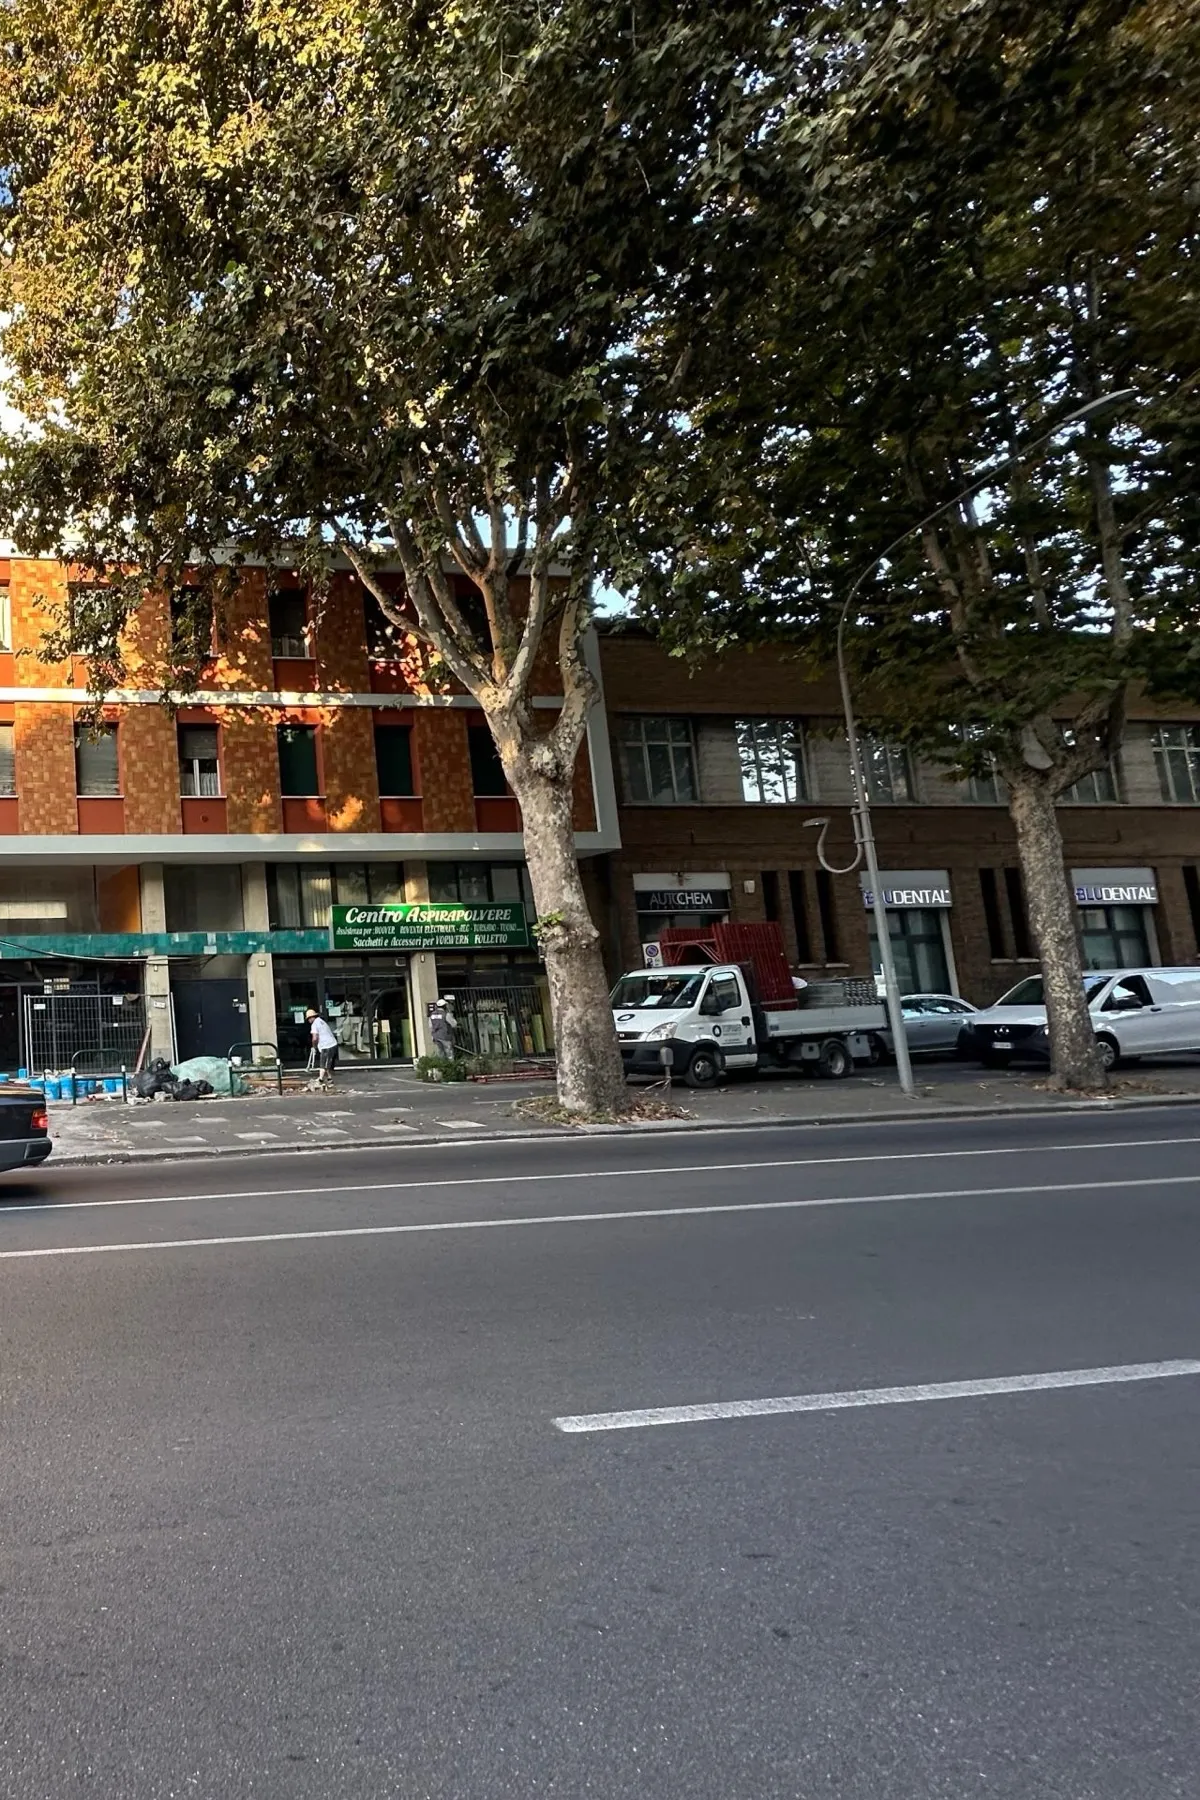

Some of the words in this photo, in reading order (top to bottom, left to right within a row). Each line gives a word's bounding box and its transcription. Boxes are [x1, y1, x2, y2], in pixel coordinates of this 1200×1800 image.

[863, 889, 951, 905] BUDENTAL
[1075, 886, 1157, 901] BLUDENTAL
[345, 907, 403, 923] Centro
[405, 906, 512, 923] ASPIRAPOLVERE
[353, 937, 383, 947] Sacchetti
[390, 935, 421, 946] Accessori
[422, 938, 434, 948] per
[474, 934, 508, 944] FOLLETTO
